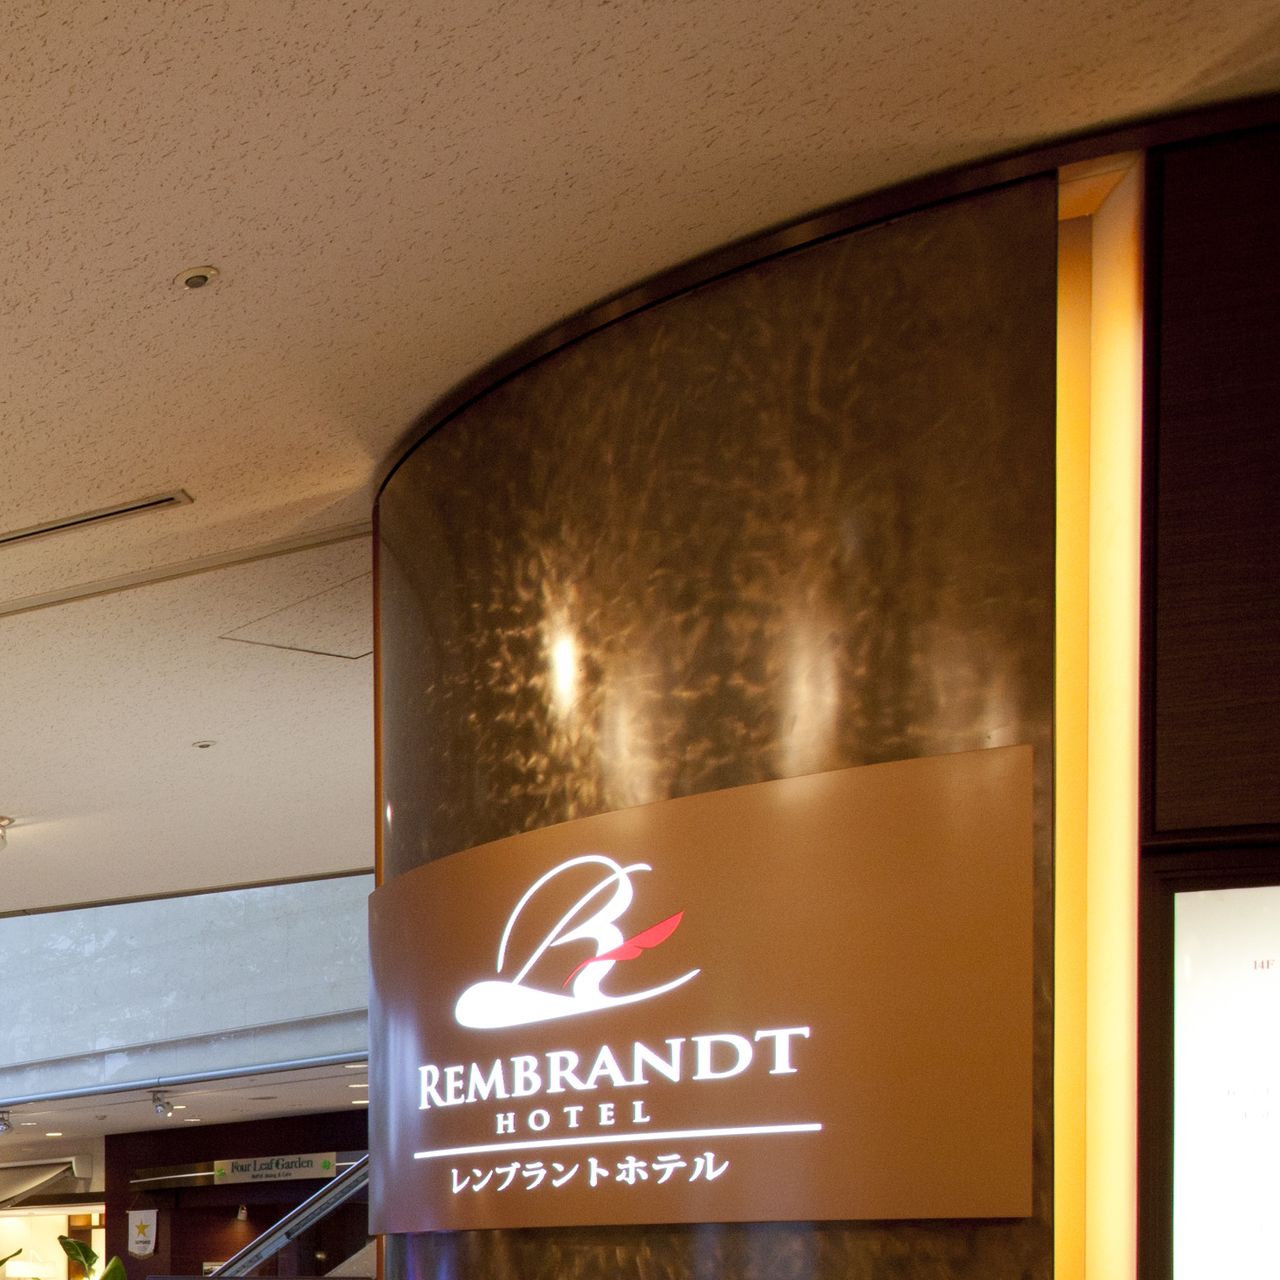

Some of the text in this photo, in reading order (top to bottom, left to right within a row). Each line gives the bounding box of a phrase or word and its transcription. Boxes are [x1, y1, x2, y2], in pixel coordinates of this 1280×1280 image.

[416, 1026, 811, 1111] REMBRANDT
[495, 1101, 652, 1135] HOTEL
[231, 1157, 313, 1173] Four Leaf Garden
[450, 1152, 731, 1195] レンブラントホテル
